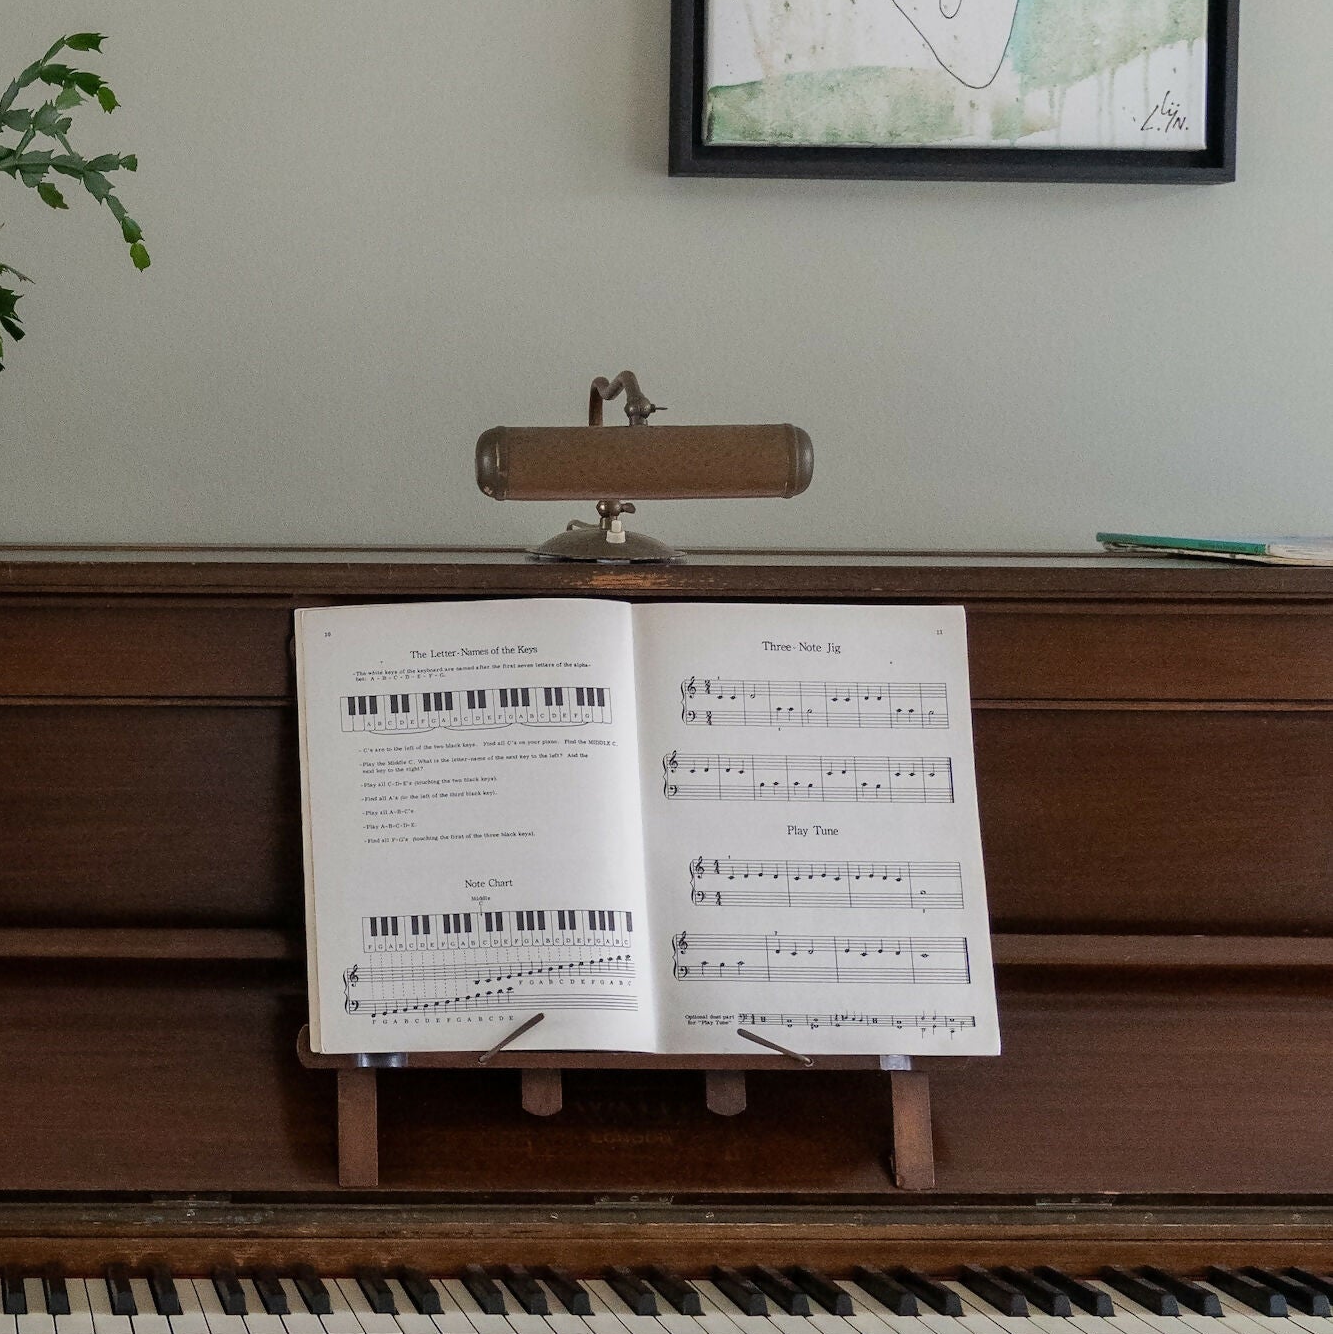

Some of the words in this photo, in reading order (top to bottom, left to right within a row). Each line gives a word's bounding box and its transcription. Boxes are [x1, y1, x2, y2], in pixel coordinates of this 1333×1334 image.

[409, 650, 427, 659] The
[430, 647, 488, 658] Letter-Names
[490, 646, 499, 655] of
[501, 646, 515, 654] the
[517, 645, 537, 655] Keys
[826, 642, 841, 654] Jig
[417, 666, 442, 674] keyboard
[787, 825, 808, 837] Play
[812, 825, 839, 836] Tune
[465, 879, 486, 888] Note
[488, 878, 513, 888] Chart
